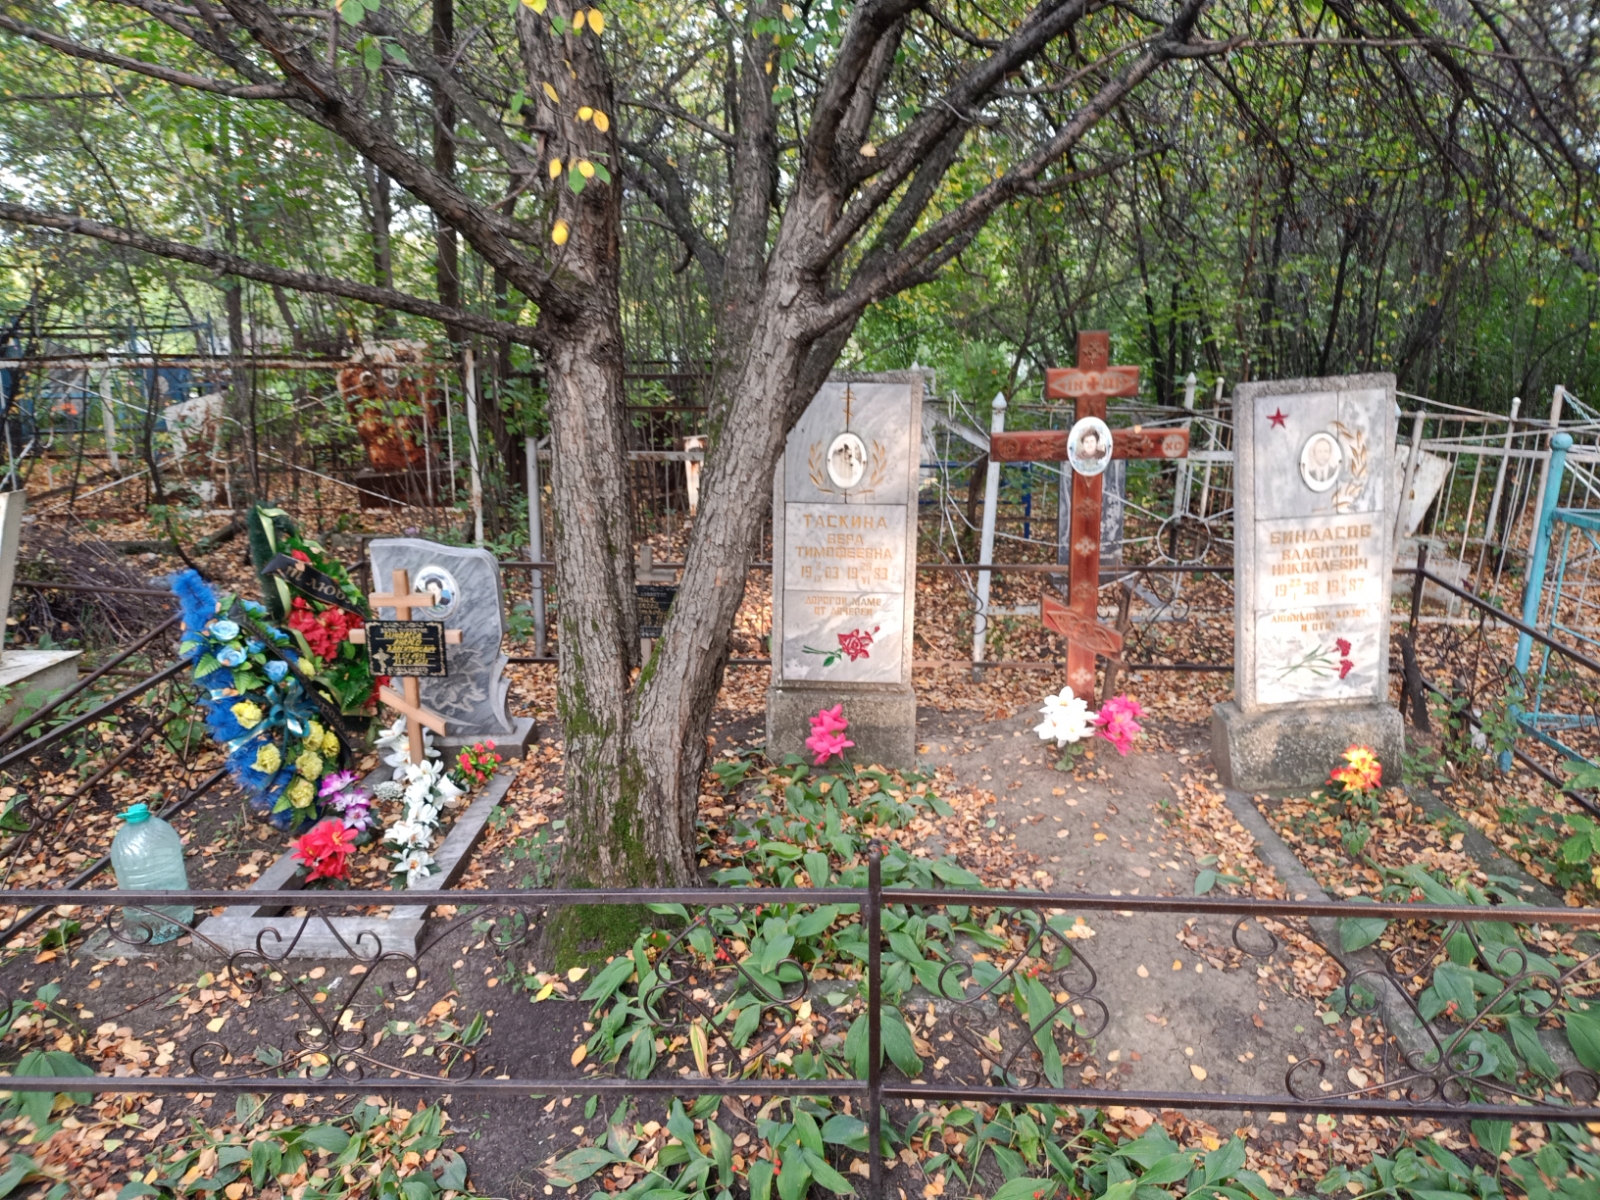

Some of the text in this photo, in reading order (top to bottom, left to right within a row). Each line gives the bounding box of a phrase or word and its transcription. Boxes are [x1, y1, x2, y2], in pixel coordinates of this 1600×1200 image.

[803, 514, 888, 529] ТАСКИНА
[827, 533, 864, 545] ВЕРА
[1270, 524, 1371, 544] БИНДАСОВ
[795, 546, 893, 560] ТИМОФЕЕВНА
[1282, 544, 1358, 560] ВАЛЕНТИН
[801, 565, 812, 578] 19
[825, 566, 839, 579] 03
[847, 567, 858, 579] 19
[874, 567, 888, 580] 83
[1272, 558, 1368, 576] НИКОЛАЕВИЧ
[1275, 584, 1287, 597] 19
[1304, 581, 1319, 595] 38
[1327, 580, 1339, 594] 19
[851, 597, 882, 606] МАМЕ
[814, 606, 825, 616] ОТ
